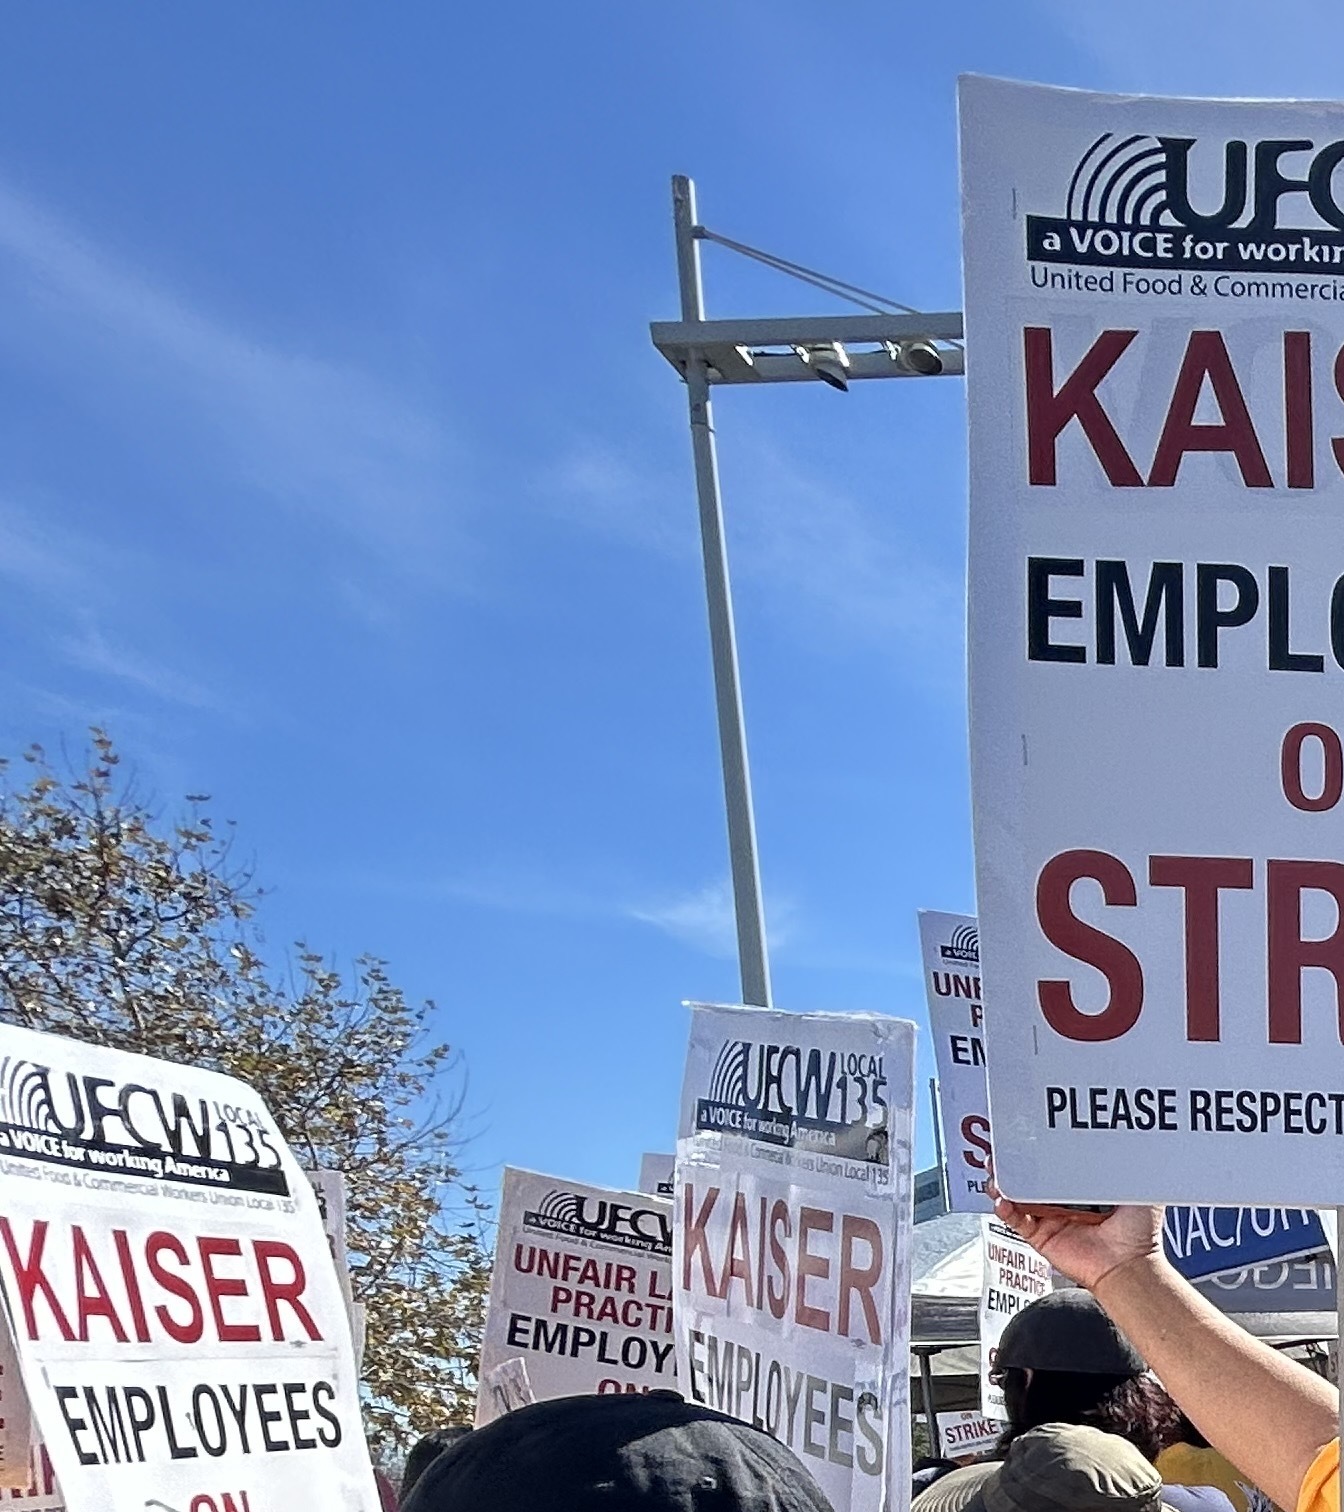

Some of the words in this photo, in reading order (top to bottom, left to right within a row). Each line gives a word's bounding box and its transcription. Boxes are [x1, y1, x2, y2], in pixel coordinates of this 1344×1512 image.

[1042, 233, 1061, 253] a
[1068, 227, 1174, 259] VOICE
[1182, 235, 1226, 261] for
[1030, 265, 1114, 294] United
[1122, 268, 1186, 296] Food
[1191, 276, 1208, 297] &
[742, 1043, 837, 1121] UFCW
[840, 1051, 887, 1080] LOCAL
[835, 1075, 889, 1130] 135
[33, 1062, 211, 1161] UFCW
[213, 1101, 267, 1133] LOCAL
[709, 1107, 743, 1130] VOICE
[744, 1111, 757, 1131] for
[791, 1120, 837, 1146] America
[1046, 1086, 1177, 1132] PLEASE
[9, 1129, 63, 1158] VOICE
[62, 1141, 88, 1161] for
[89, 1146, 165, 1179] working
[165, 1155, 231, 1183] America
[215, 1121, 283, 1171] 135
[0, 1215, 325, 1345] KAISER
[514, 1243, 637, 1294] UNFAIR
[682, 1183, 883, 1346] KAISER
[988, 1242, 1026, 1272] UNFAIR
[551, 1285, 674, 1334] PRACTI
[507, 1312, 674, 1375] EMPLOY
[52, 1380, 343, 1466] EMPLOYEES
[688, 1328, 884, 1477] EMPLOYEES
[944, 1419, 999, 1444] STRIKE
